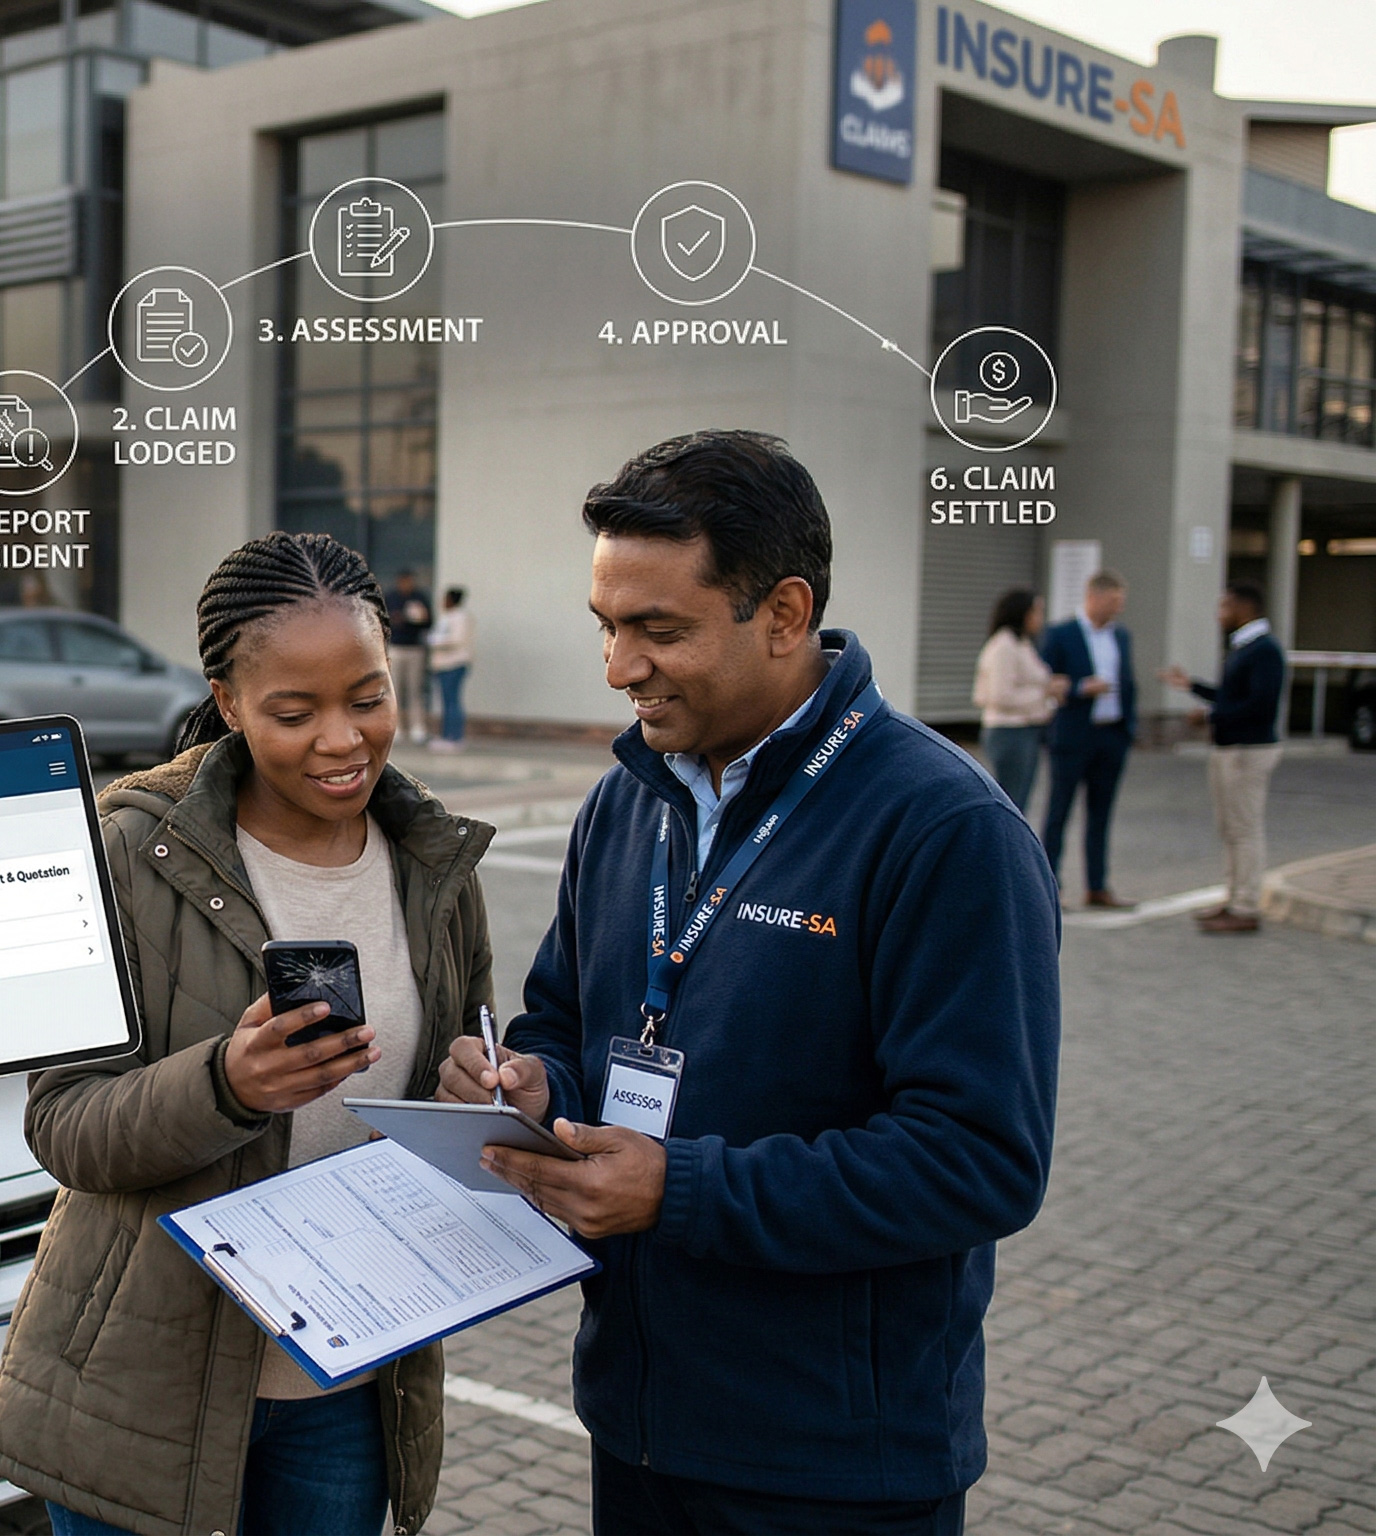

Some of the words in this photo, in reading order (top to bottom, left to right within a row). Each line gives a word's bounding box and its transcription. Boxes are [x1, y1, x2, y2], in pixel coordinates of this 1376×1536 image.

[937, 6, 1186, 149] INSURE-SA
[804, 711, 864, 777] INSURE-SA
[6, 872, 15, 883] &
[652, 885, 665, 957] INSURE-SA
[678, 886, 727, 951] INSURE-SA
[737, 902, 837, 937] INSURE-SA
[612, 1088, 662, 1112] ASSESSOR
